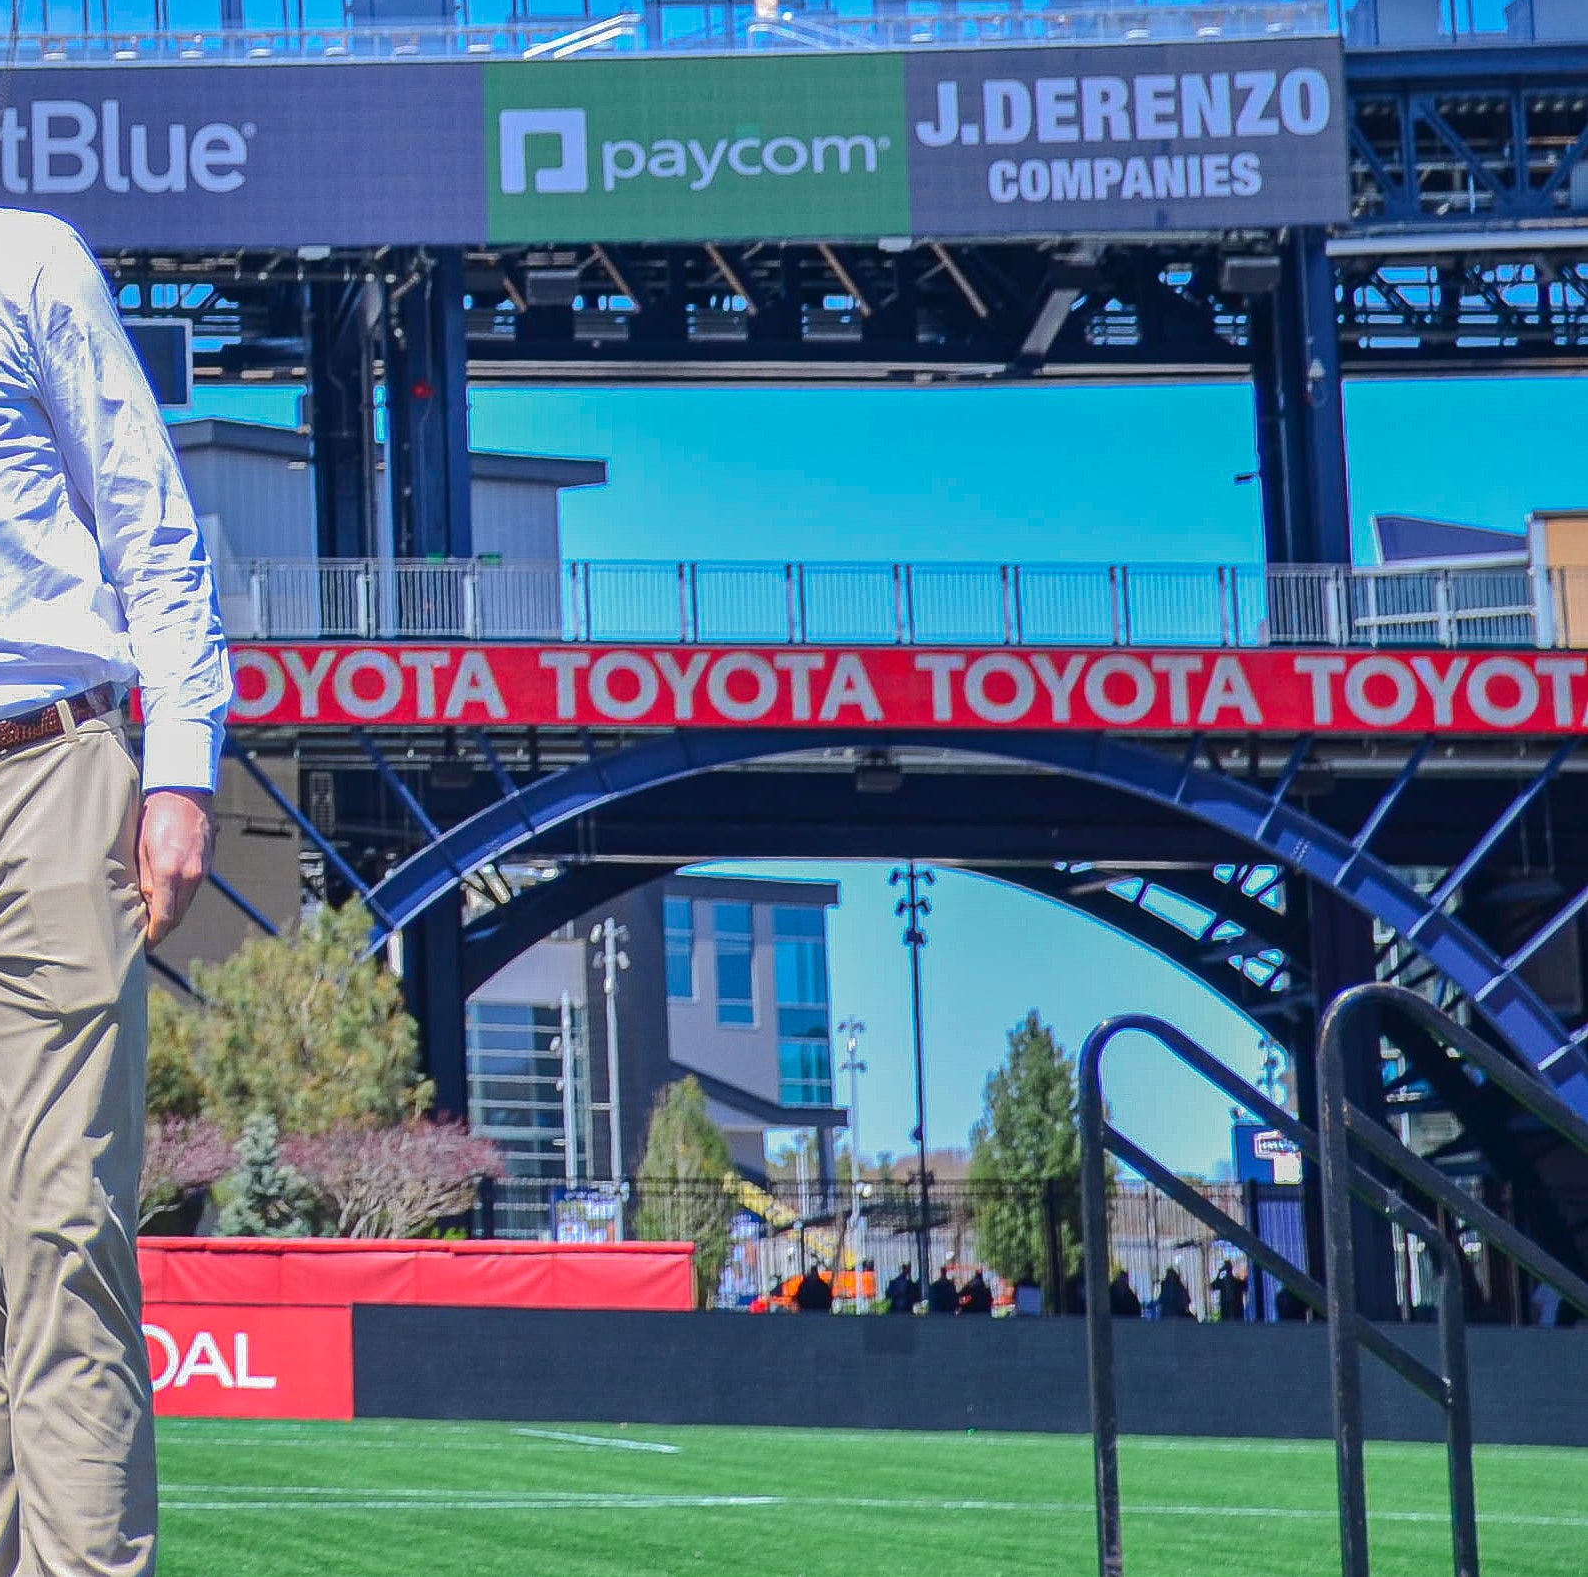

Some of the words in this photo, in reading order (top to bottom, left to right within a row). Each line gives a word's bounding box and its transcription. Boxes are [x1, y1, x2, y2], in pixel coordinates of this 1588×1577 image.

[914, 66, 1332, 149] J.DERENZO
[601, 134, 878, 192] paycom
[986, 151, 1263, 204] COMPANIES
[539, 650, 884, 722] TOYOTA
[912, 653, 1266, 724] TOYOTA
[1293, 655, 1588, 727] TOYOT
